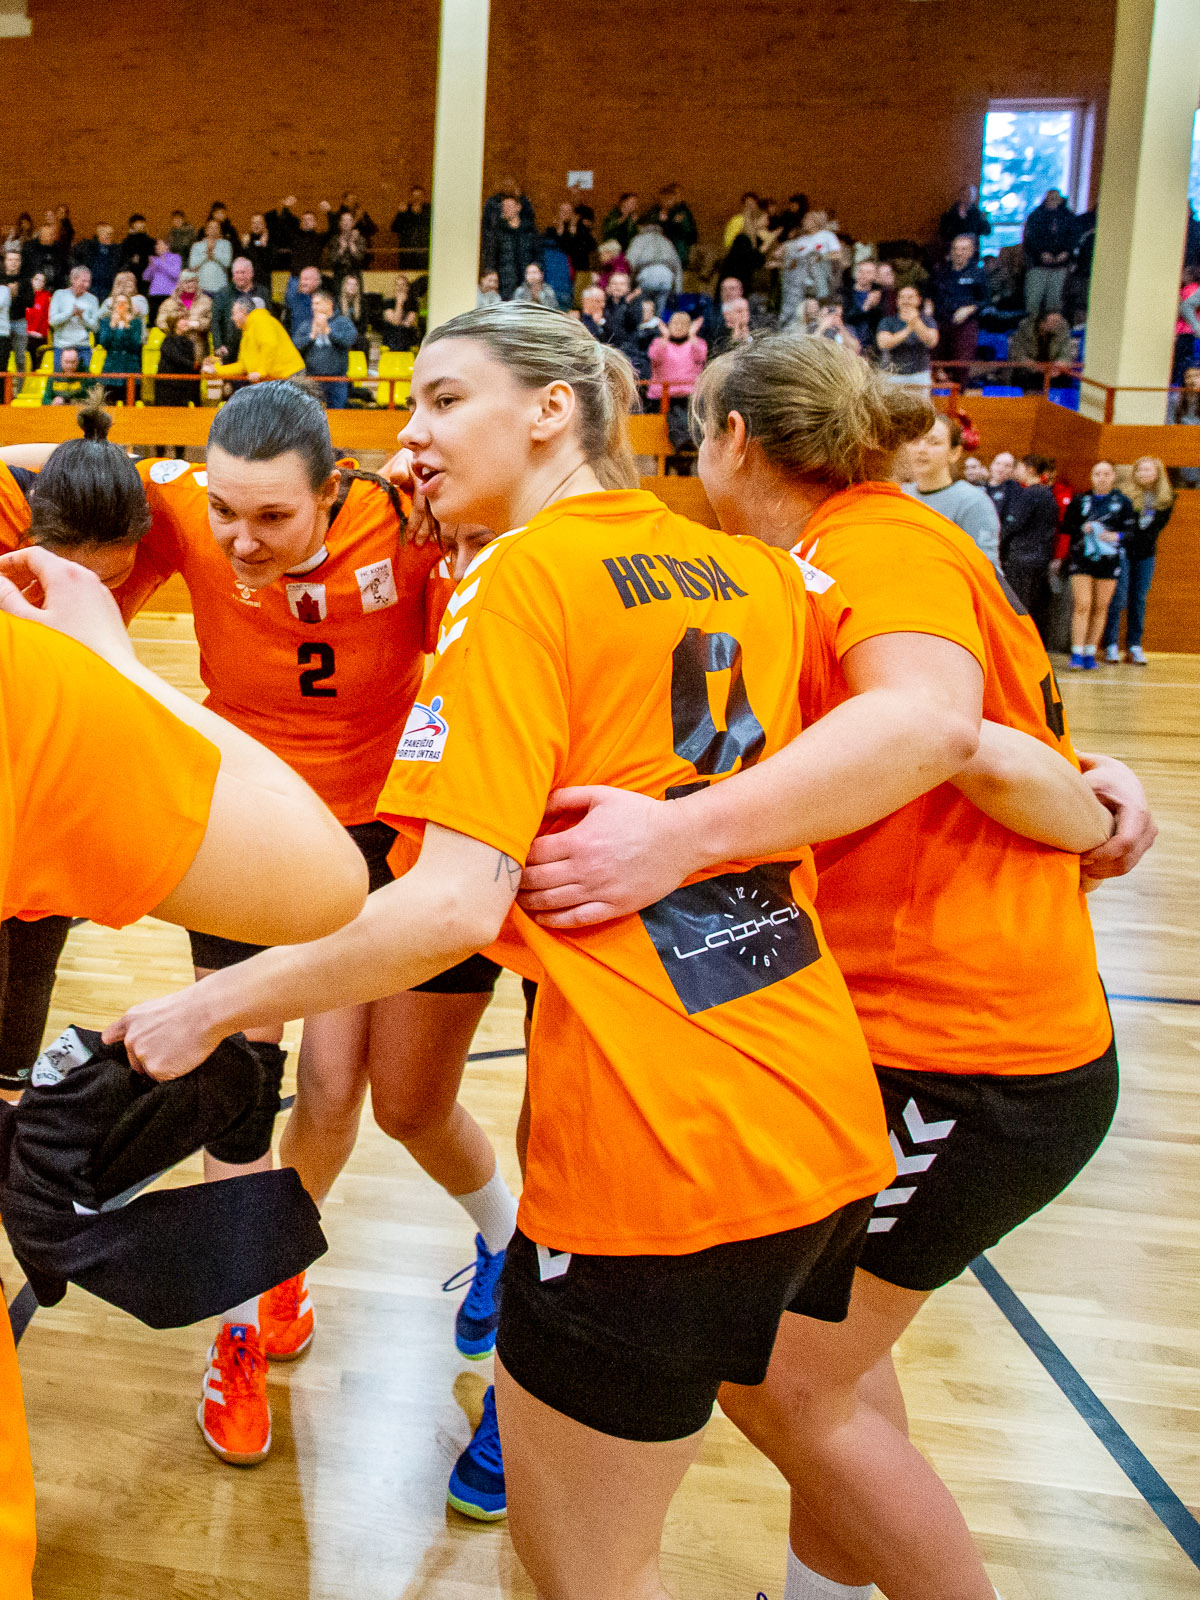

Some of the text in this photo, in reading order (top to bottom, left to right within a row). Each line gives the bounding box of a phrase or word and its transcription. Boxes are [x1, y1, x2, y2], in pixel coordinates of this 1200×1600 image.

[601, 553, 672, 610] HC
[297, 642, 337, 698] 2
[735, 886, 745, 899] 12
